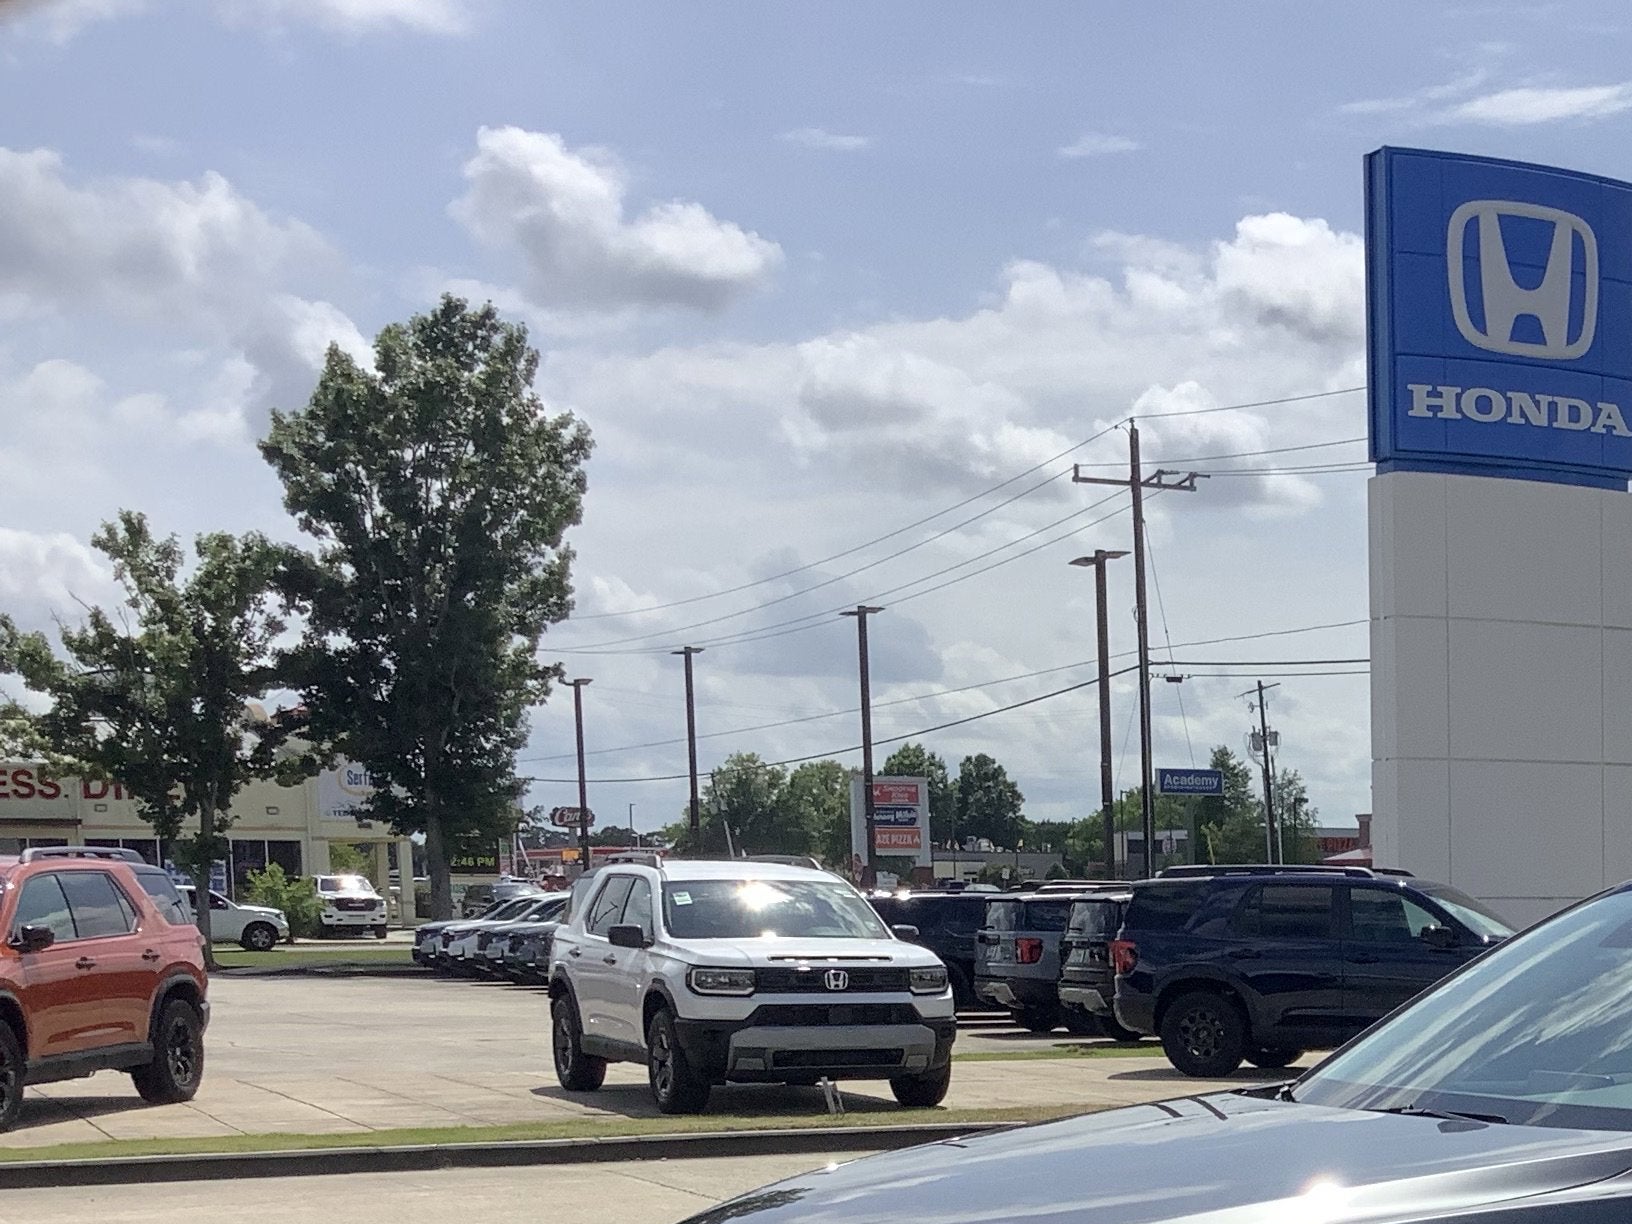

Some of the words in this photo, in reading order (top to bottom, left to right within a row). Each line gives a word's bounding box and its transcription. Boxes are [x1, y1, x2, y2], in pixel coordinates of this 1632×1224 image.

[1407, 383, 1632, 437] HONDA
[1164, 773, 1219, 789] Academy
[476, 856, 496, 867] PM
